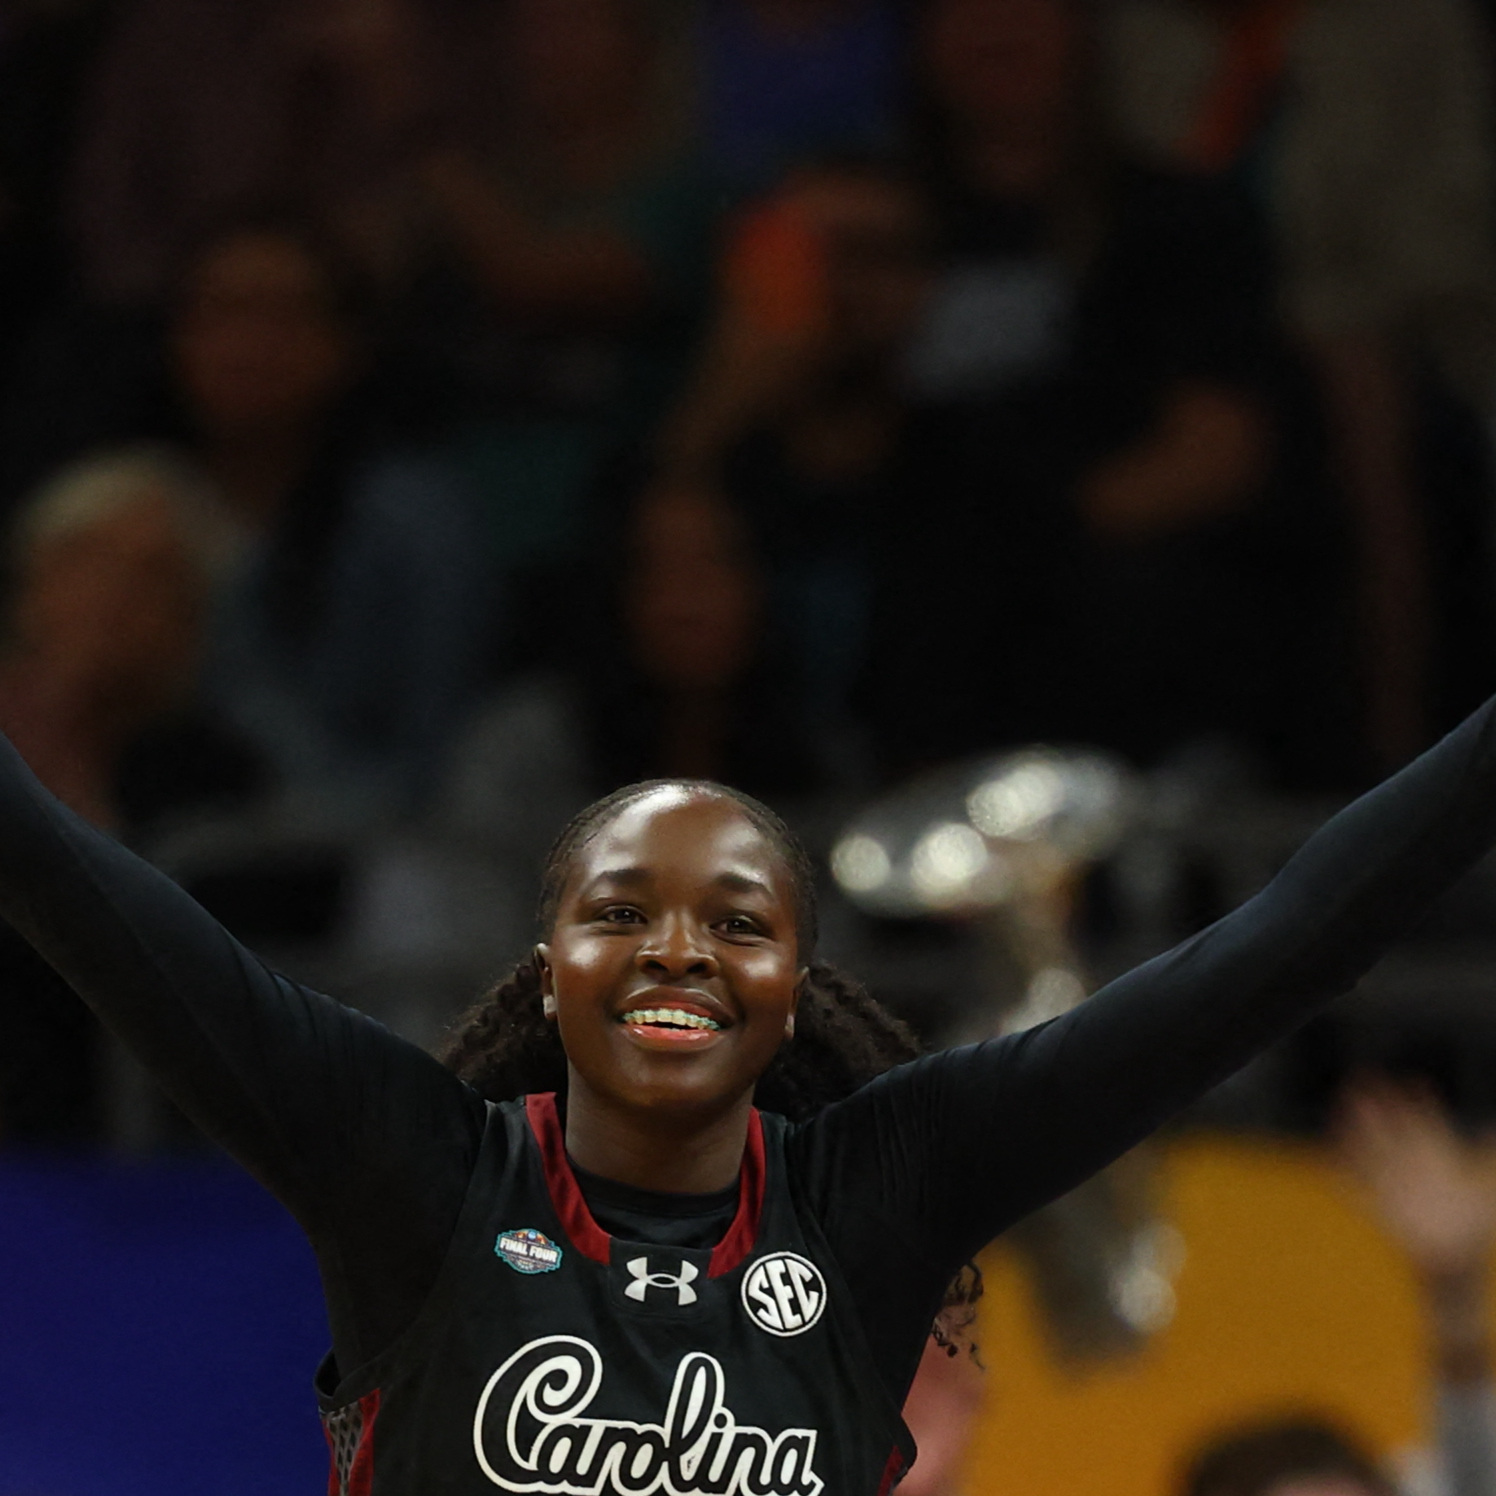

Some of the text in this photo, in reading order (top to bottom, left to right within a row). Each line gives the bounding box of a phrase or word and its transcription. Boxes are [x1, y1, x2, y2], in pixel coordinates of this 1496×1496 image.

[500, 1237, 558, 1263] FINAL FOUR
[748, 1258, 820, 1330] SEC
